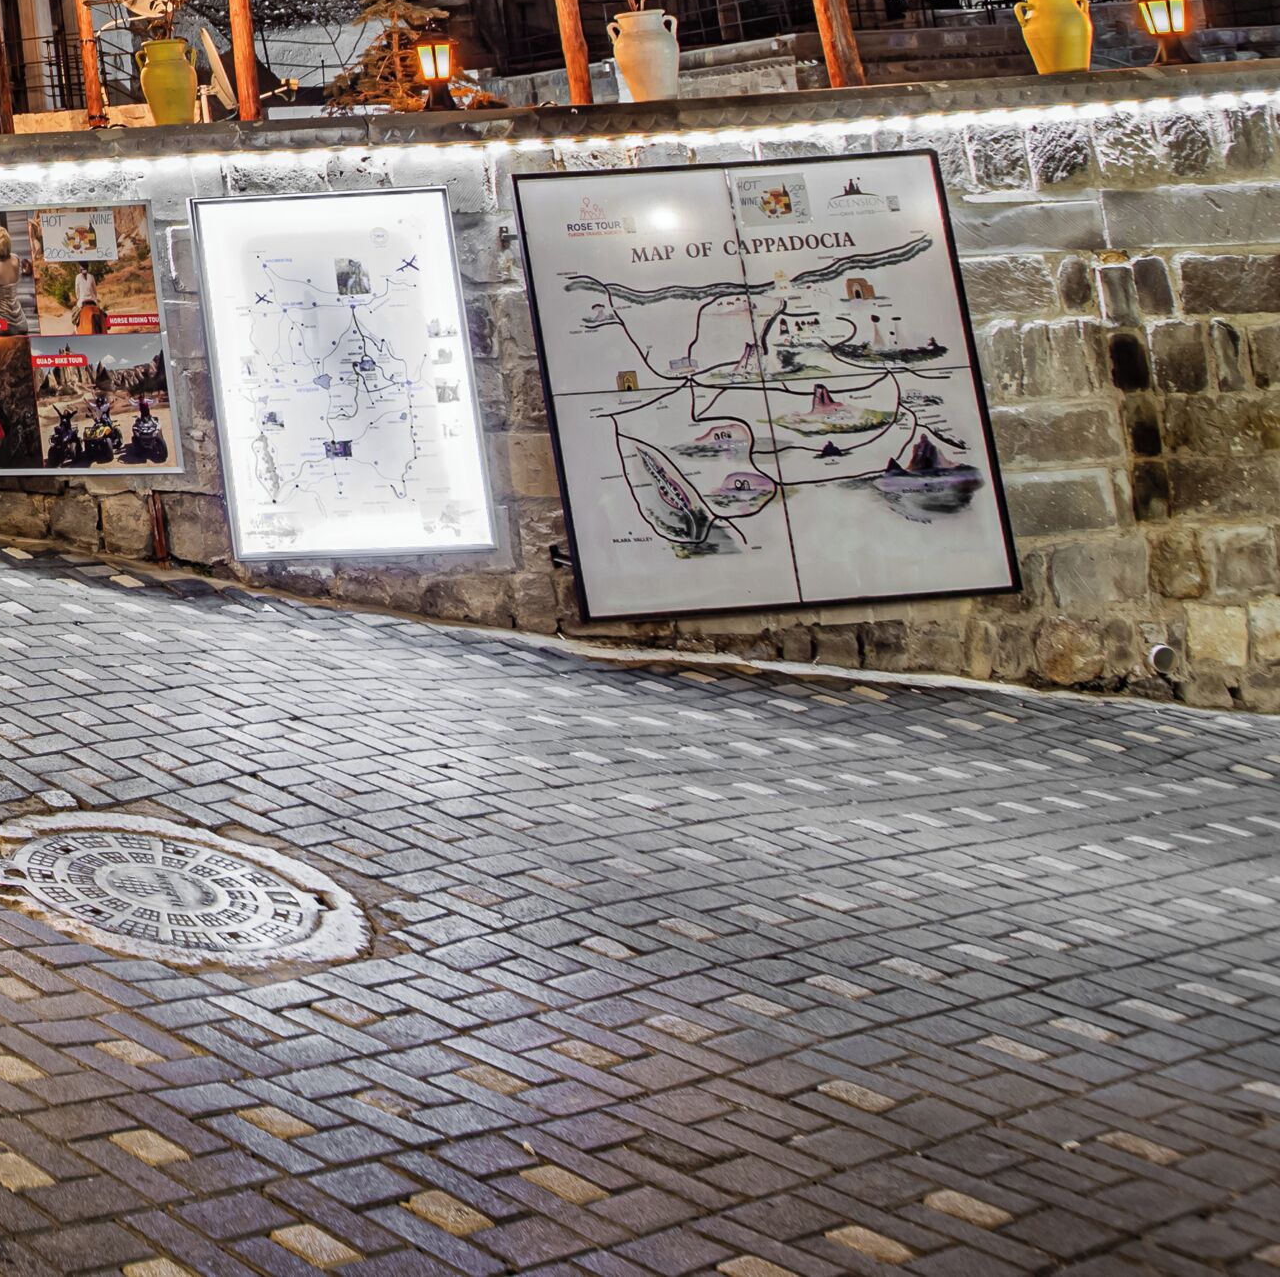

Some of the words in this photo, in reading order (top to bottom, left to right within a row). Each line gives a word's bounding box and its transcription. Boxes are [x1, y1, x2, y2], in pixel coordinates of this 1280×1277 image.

[736, 180, 761, 194] HOT
[739, 196, 759, 206] WINE
[827, 197, 885, 210] ASCENSION
[41, 214, 66, 228] HOT
[89, 213, 113, 225] WINE
[566, 222, 594, 232] ROSE
[595, 220, 622, 230] TOUR
[631, 245, 676, 263] MAP
[685, 241, 713, 259] OF
[723, 231, 857, 256] CAPPADOCIA
[109, 316, 128, 324] HORSE
[128, 316, 148, 324] RIDING
[54, 357, 68, 365] BIKE
